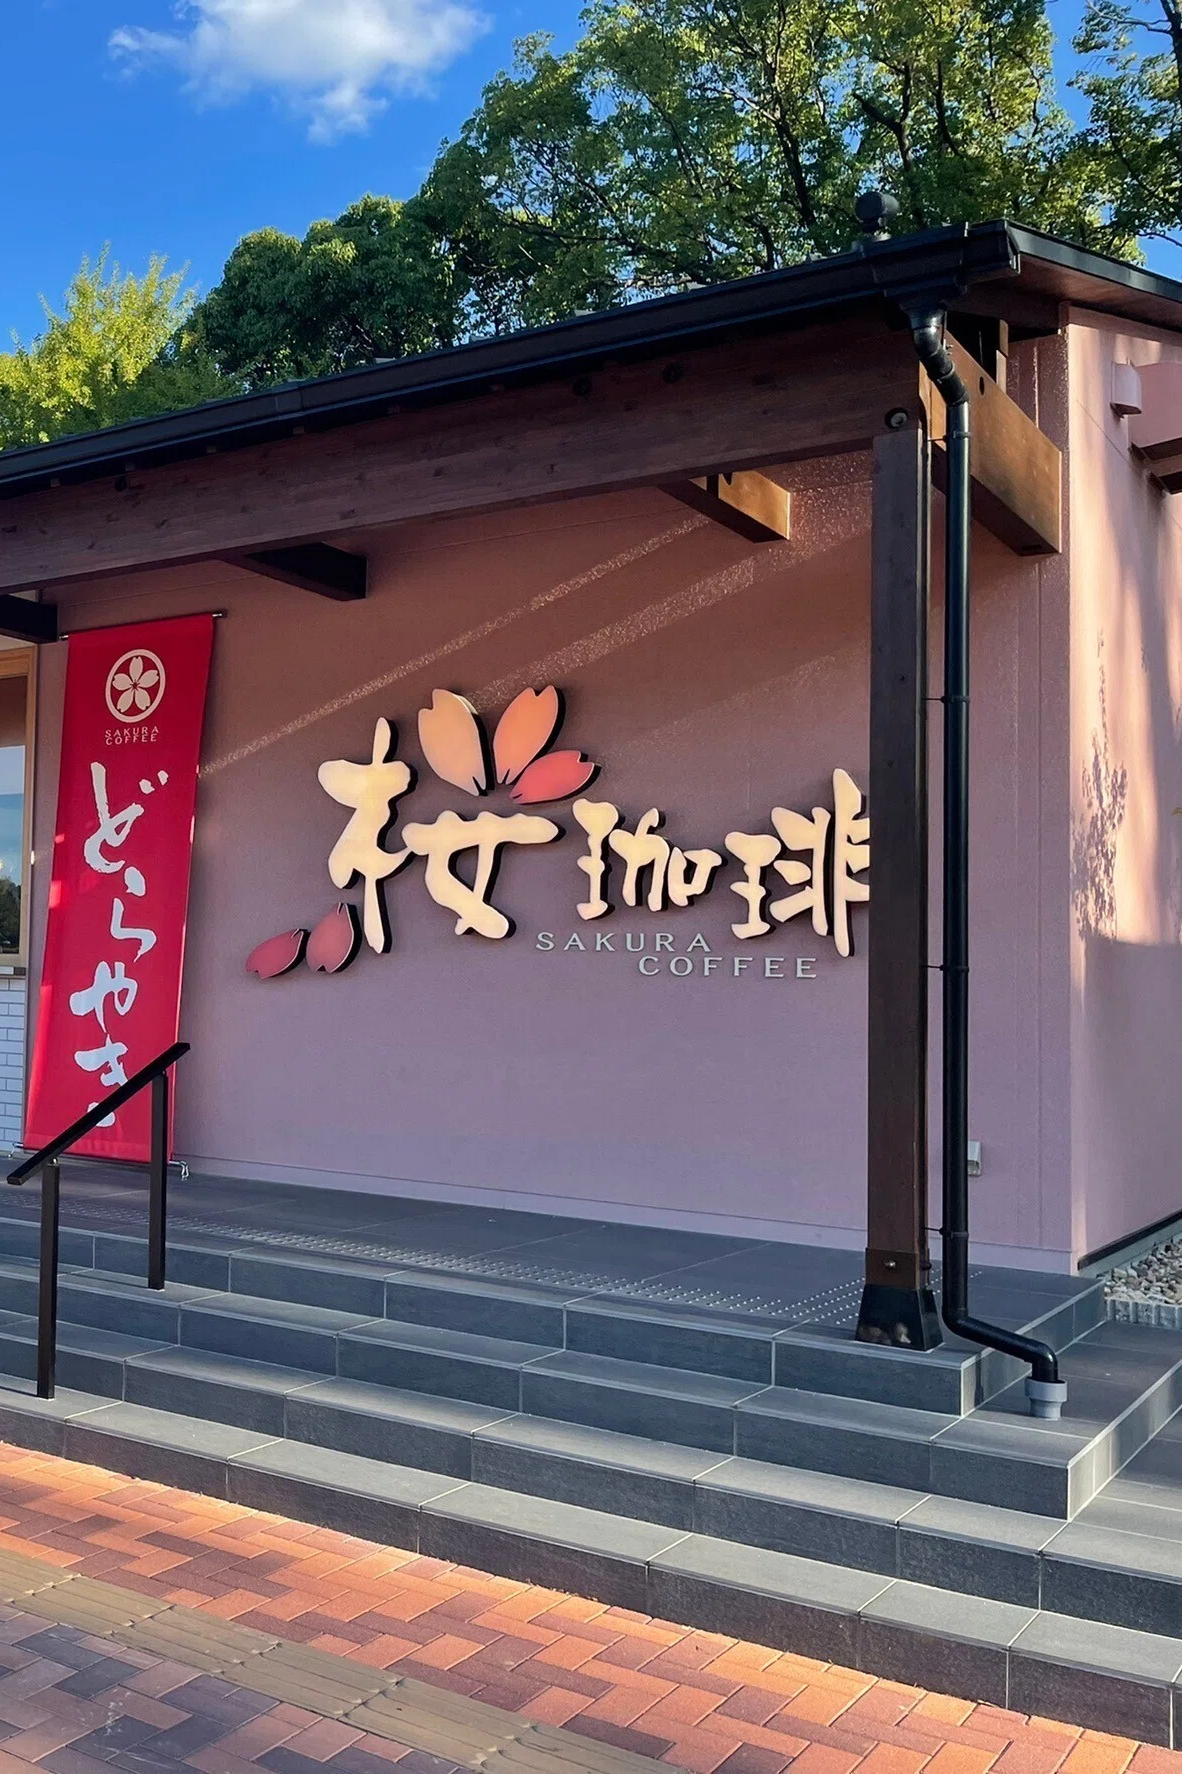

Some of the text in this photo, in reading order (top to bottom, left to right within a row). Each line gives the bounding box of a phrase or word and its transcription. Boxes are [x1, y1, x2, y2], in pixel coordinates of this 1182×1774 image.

[105, 726, 159, 738] SAKURA
[105, 734, 157, 745] COFFEE
[318, 684, 870, 957] 桜珈琲
[69, 761, 169, 1128] どらやき
[536, 932, 712, 952] SAKURA
[638, 956, 817, 978] COFFEE
